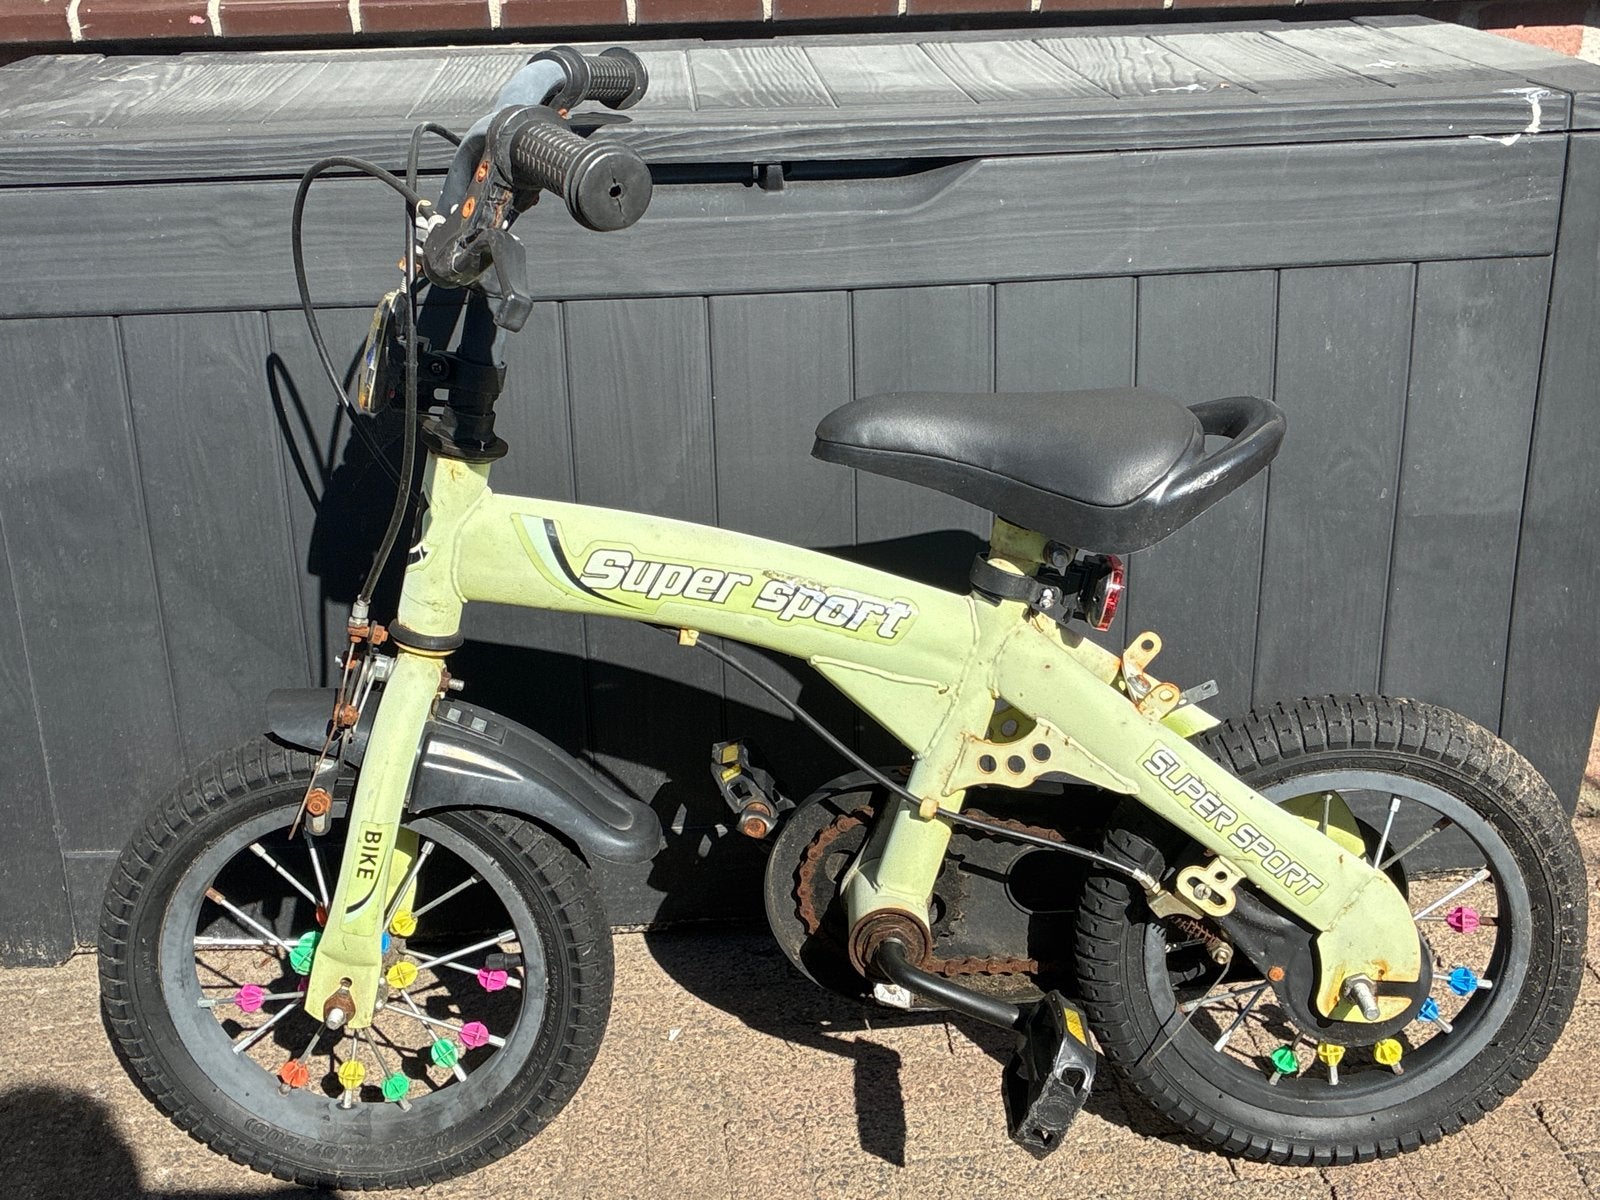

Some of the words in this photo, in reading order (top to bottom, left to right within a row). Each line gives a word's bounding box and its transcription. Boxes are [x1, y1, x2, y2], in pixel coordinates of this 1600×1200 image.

[579, 549, 753, 604] Super
[752, 577, 912, 639] sport
[356, 830, 382, 880] BIKE
[1142, 749, 1238, 832] SUPER
[1227, 823, 1324, 896] SPORT
